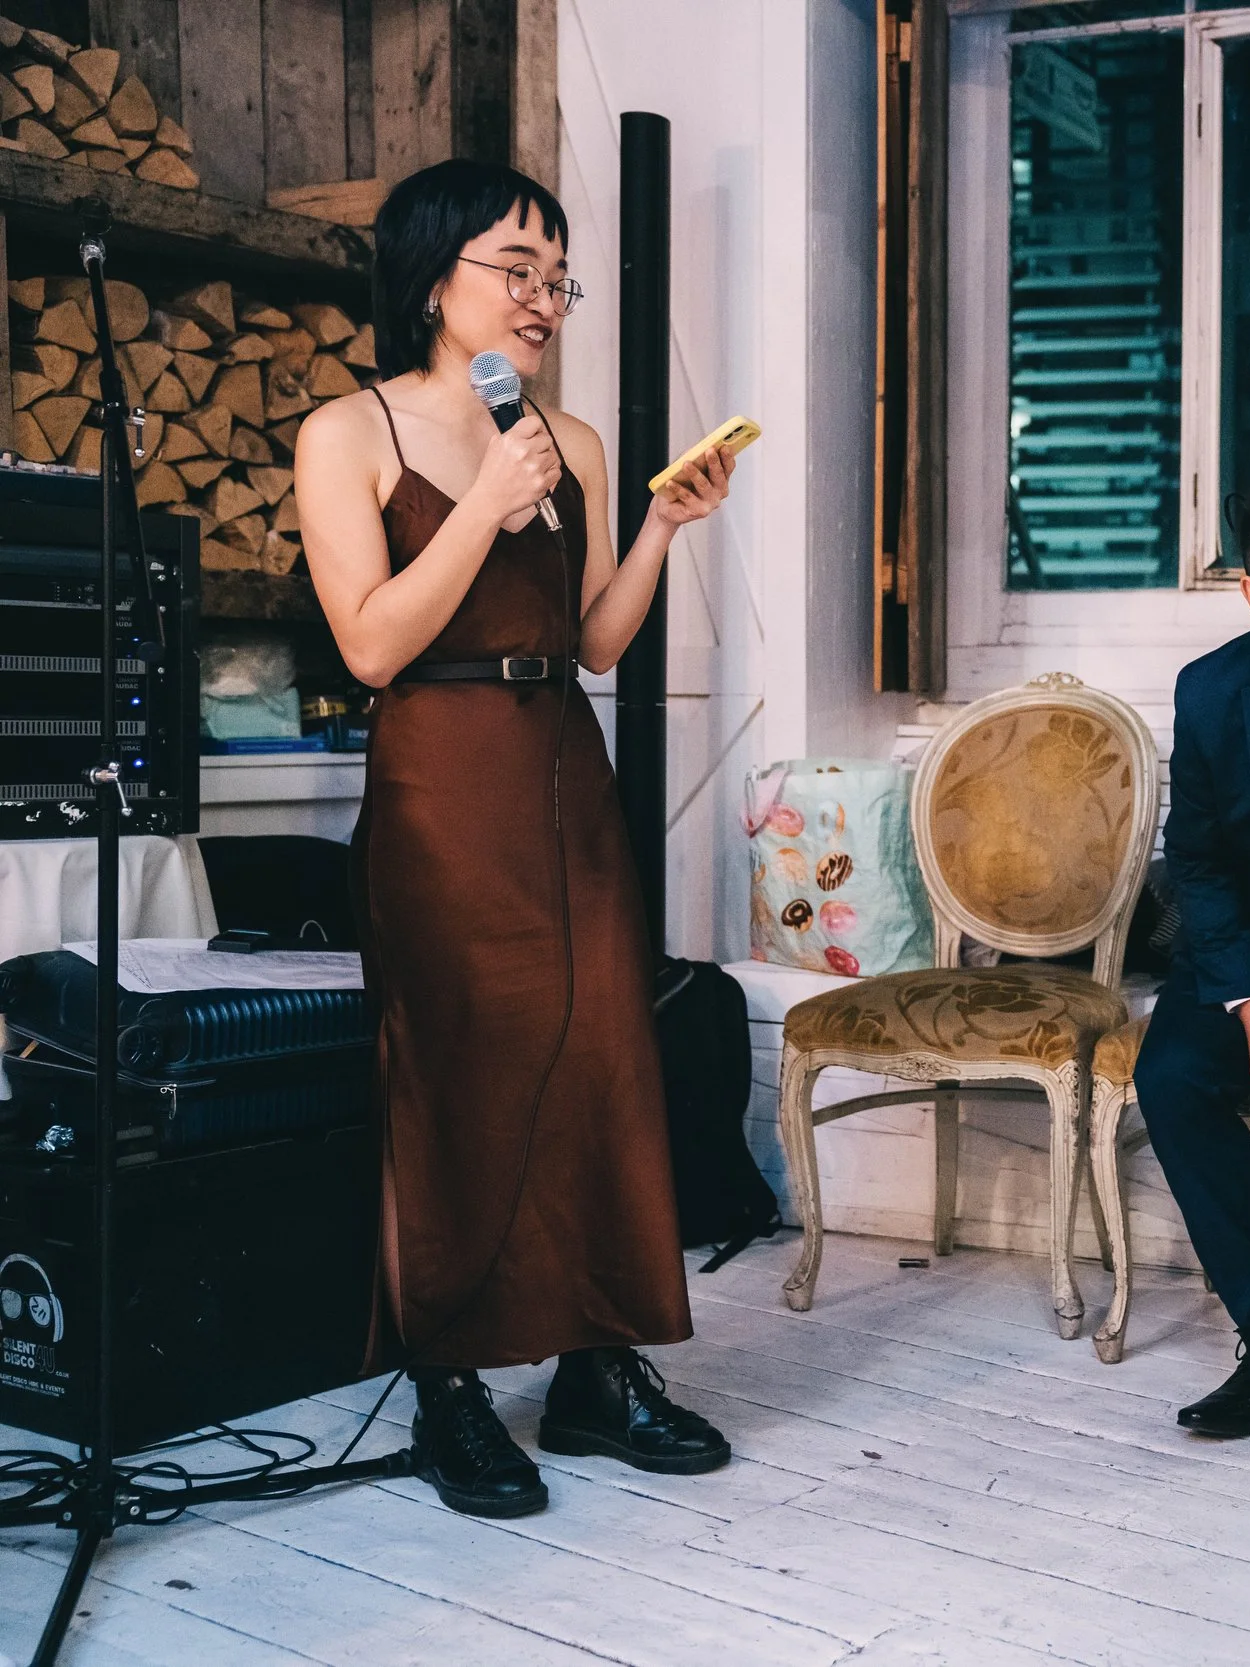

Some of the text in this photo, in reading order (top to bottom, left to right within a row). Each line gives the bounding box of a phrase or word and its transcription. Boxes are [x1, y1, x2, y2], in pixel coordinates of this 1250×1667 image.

[3, 1337, 36, 1355] SILENT
[4, 1351, 35, 1369] DISCO
[35, 1345, 55, 1373] 4U
